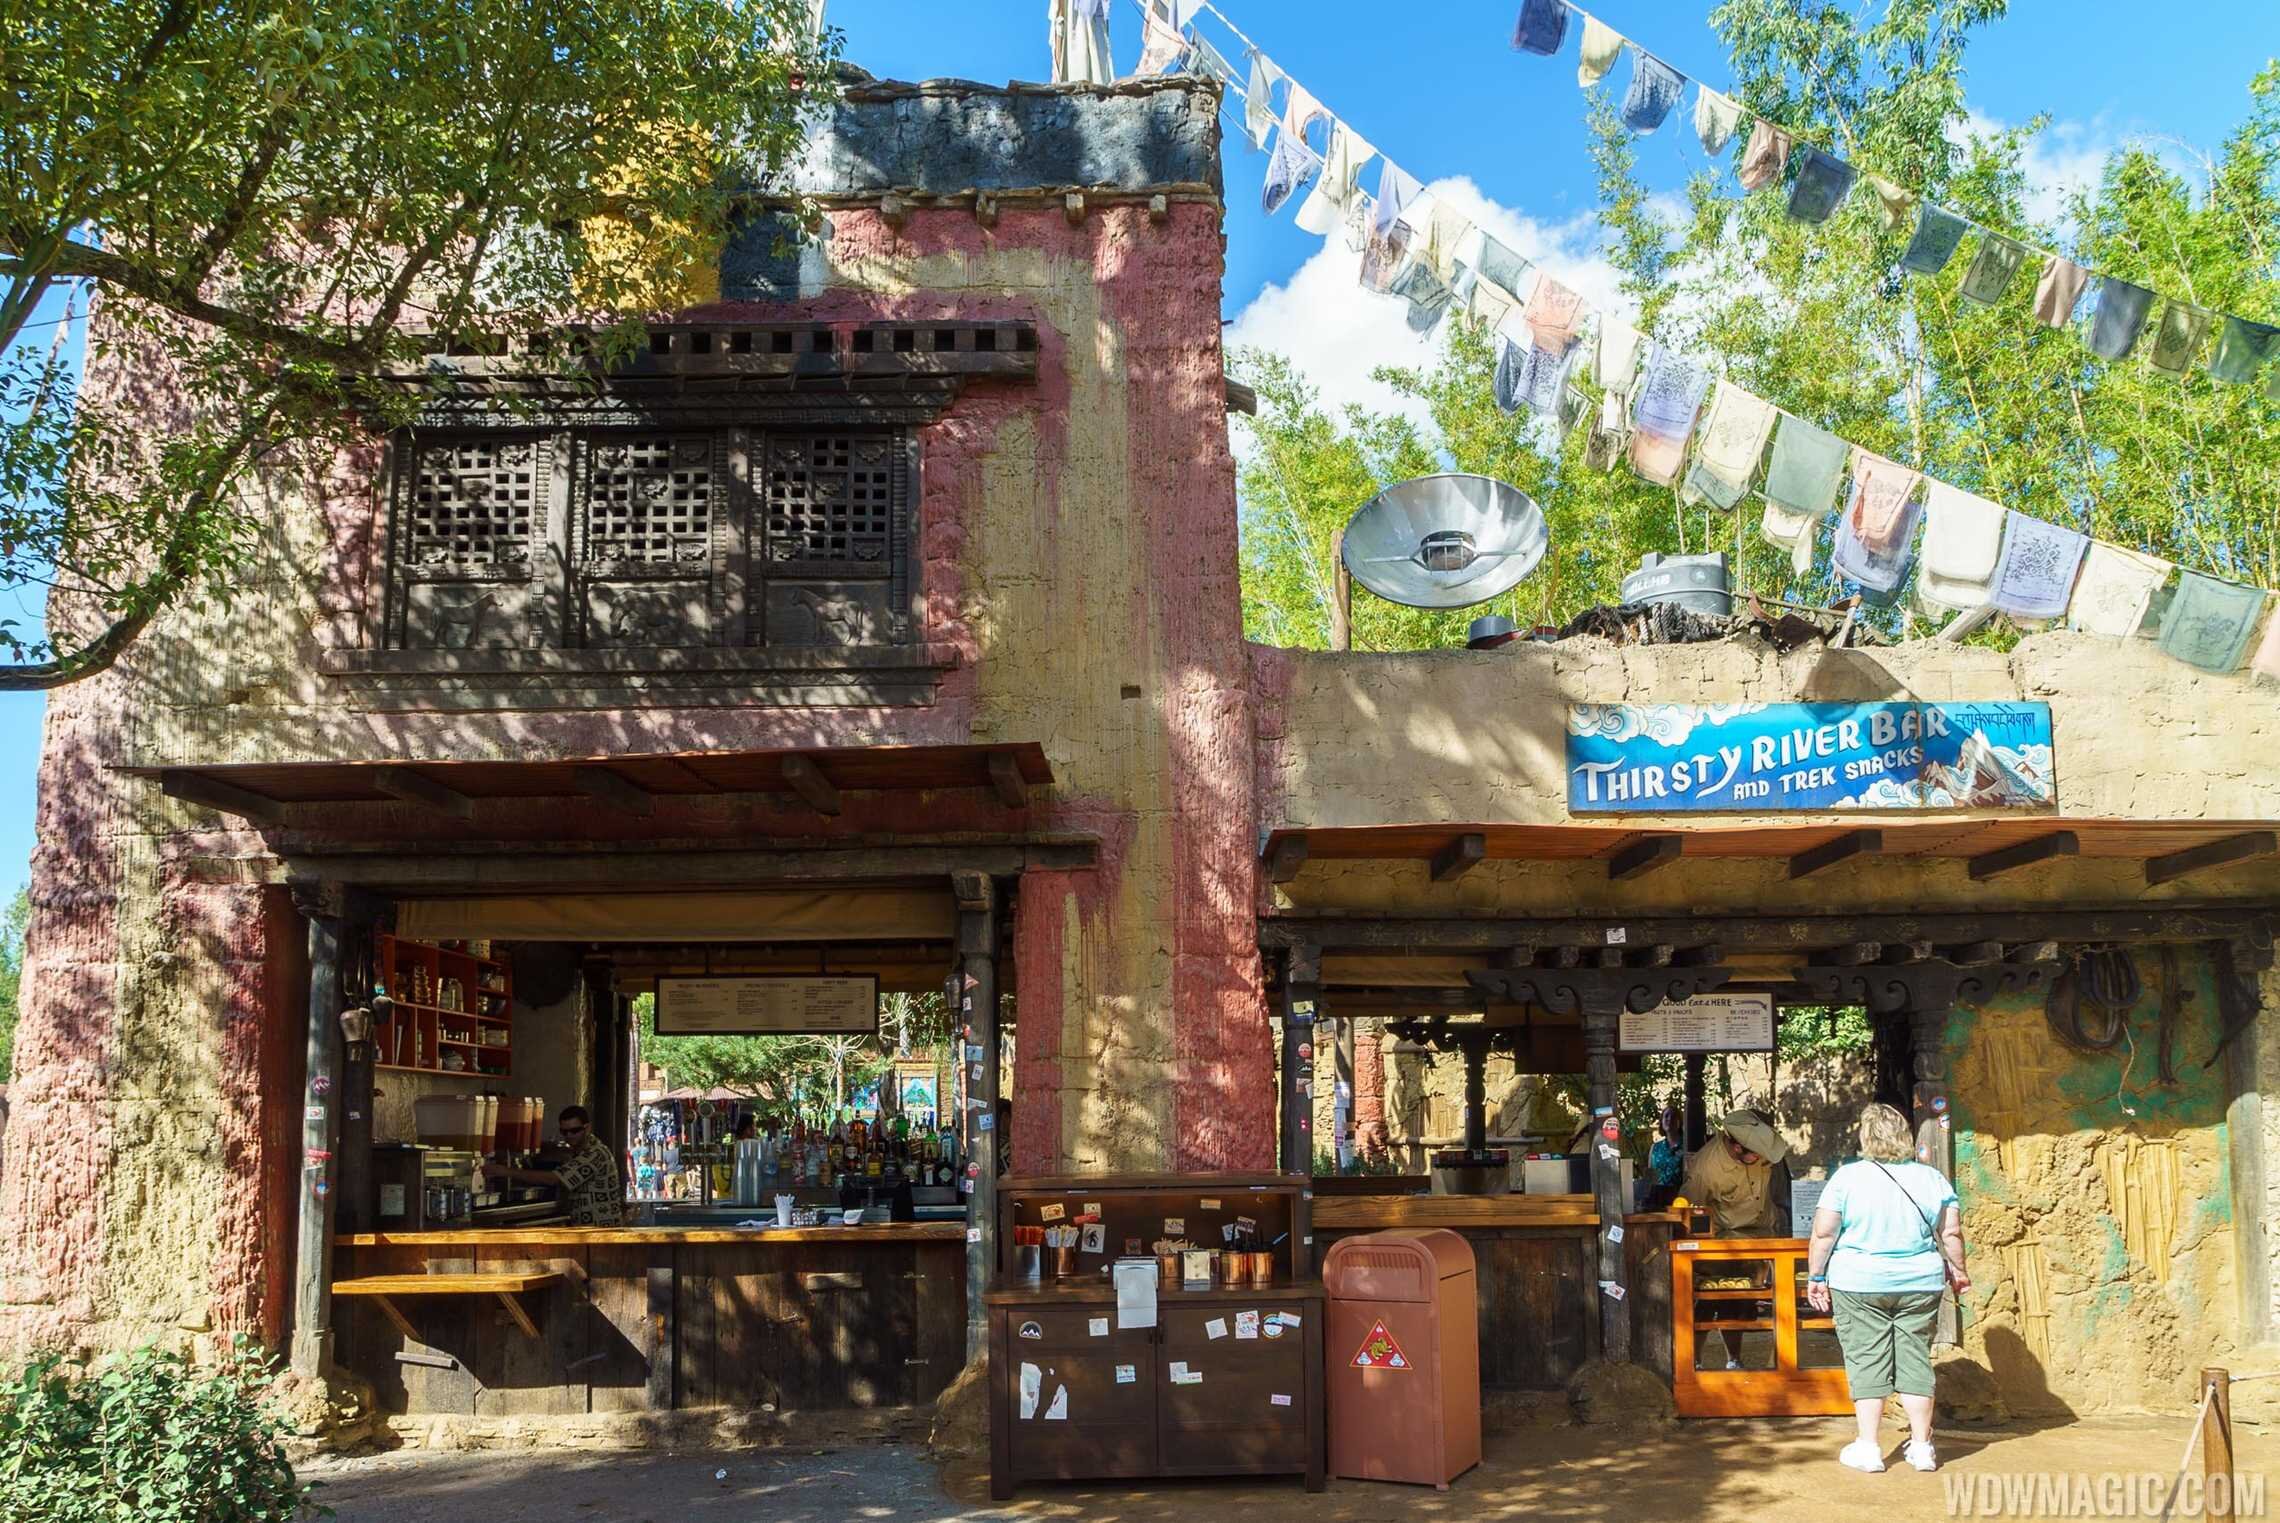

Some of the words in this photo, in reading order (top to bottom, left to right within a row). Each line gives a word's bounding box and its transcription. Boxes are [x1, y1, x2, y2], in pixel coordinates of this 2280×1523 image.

[1572, 745, 1742, 801] THIRSTY
[1752, 719, 1862, 773] RIVER
[1870, 706, 1951, 747] BAR
[1733, 780, 1770, 801] AND
[1778, 766, 1837, 794] TREK
[1844, 745, 1924, 780] SNACKS
[1711, 997, 1732, 1007] HERE
